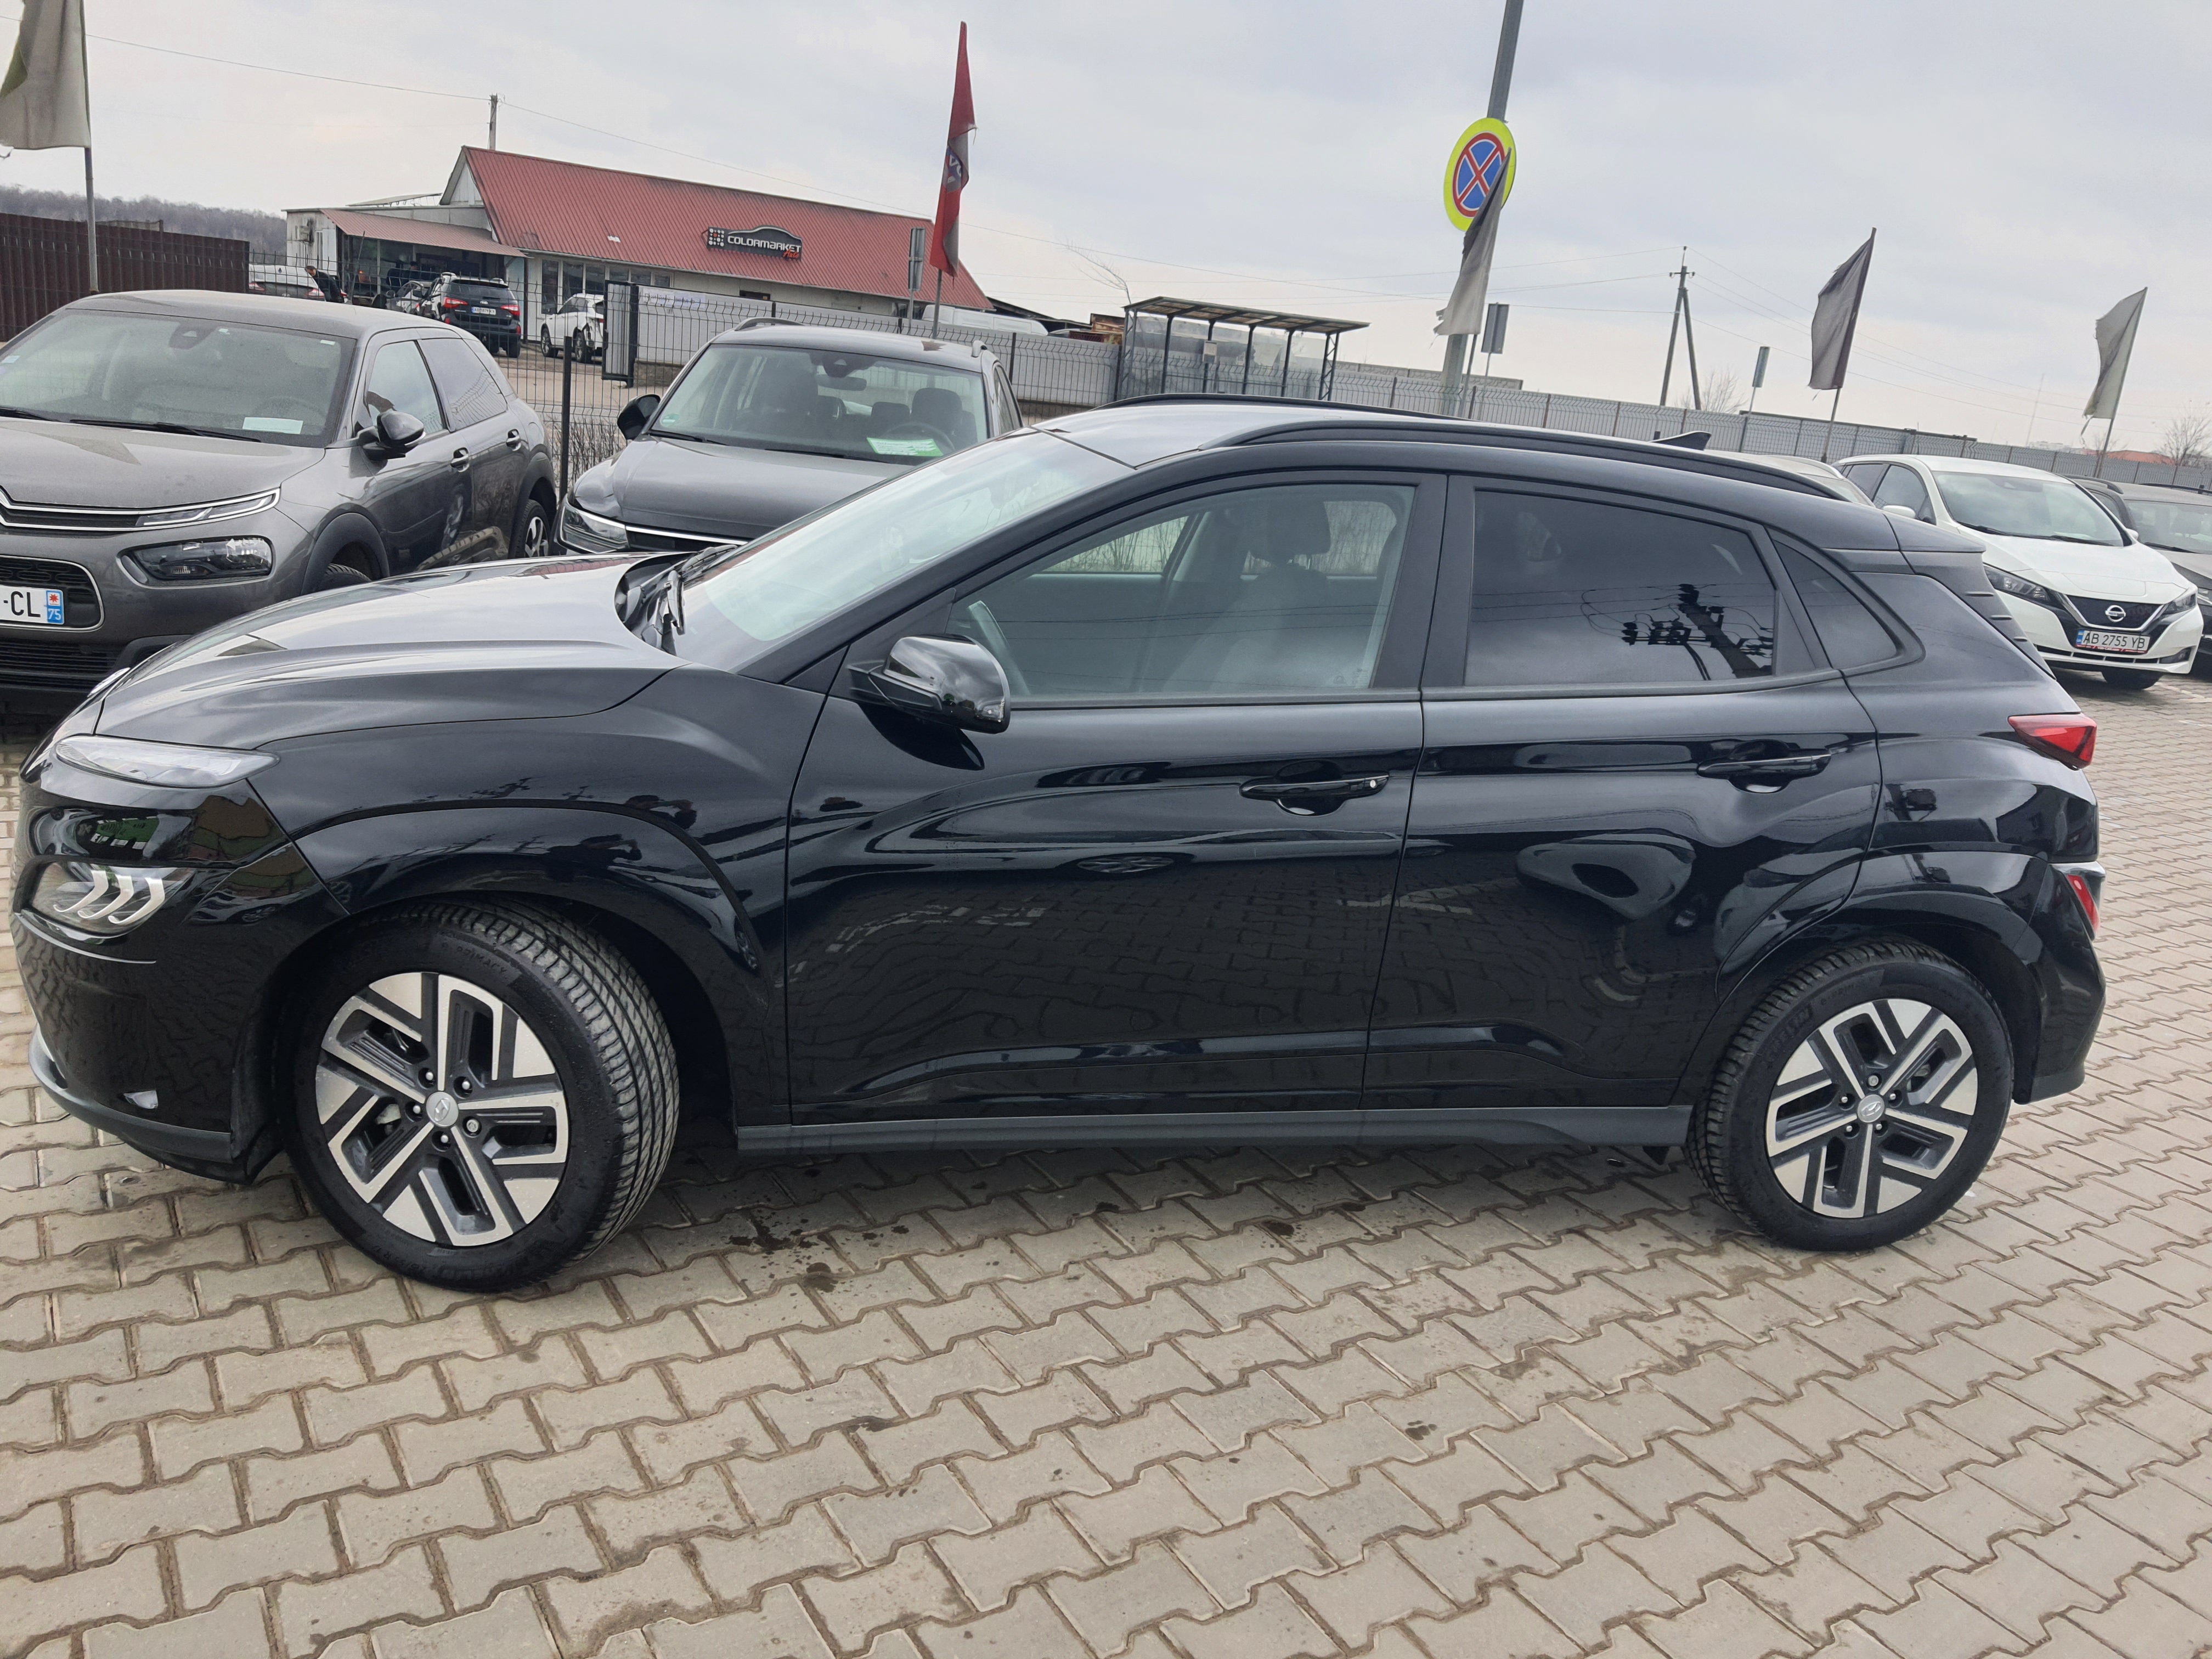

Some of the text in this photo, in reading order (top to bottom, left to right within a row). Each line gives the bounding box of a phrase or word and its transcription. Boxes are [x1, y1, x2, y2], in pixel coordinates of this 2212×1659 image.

[783, 249, 799, 258] Auto
[48, 608, 61, 620] 75
[2083, 632, 2146, 648] AB 2755 YB
